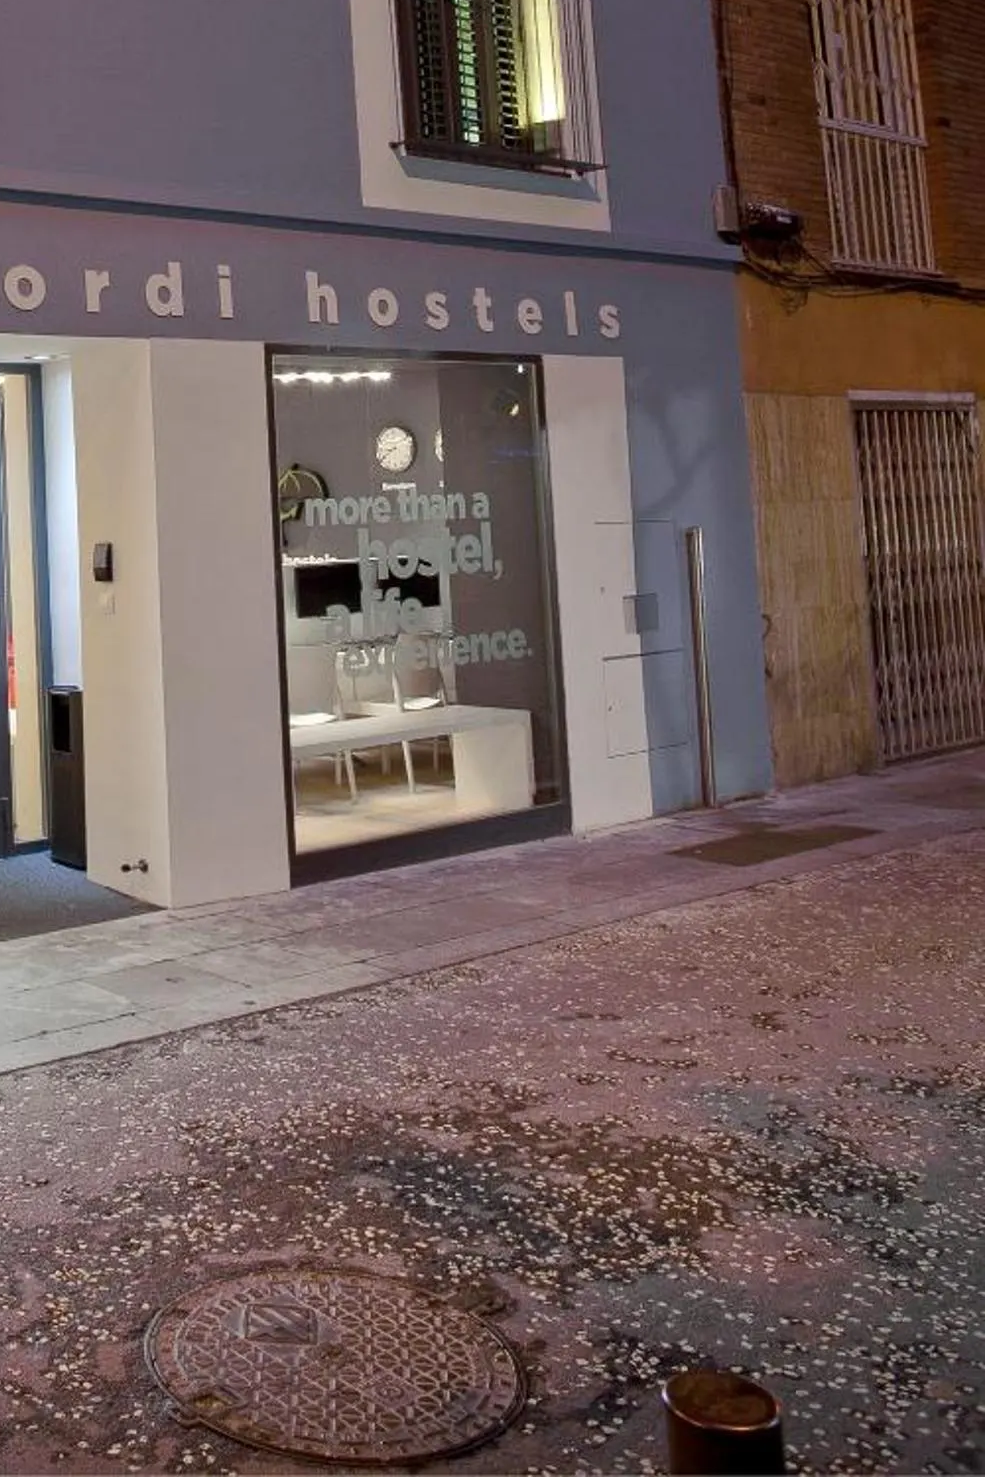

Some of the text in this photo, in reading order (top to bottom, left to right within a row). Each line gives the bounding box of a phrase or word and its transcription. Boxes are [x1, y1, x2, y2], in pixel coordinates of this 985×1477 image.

[306, 271, 621, 338] hostels
[306, 490, 491, 525] more than a
[357, 522, 504, 580] hostel,
